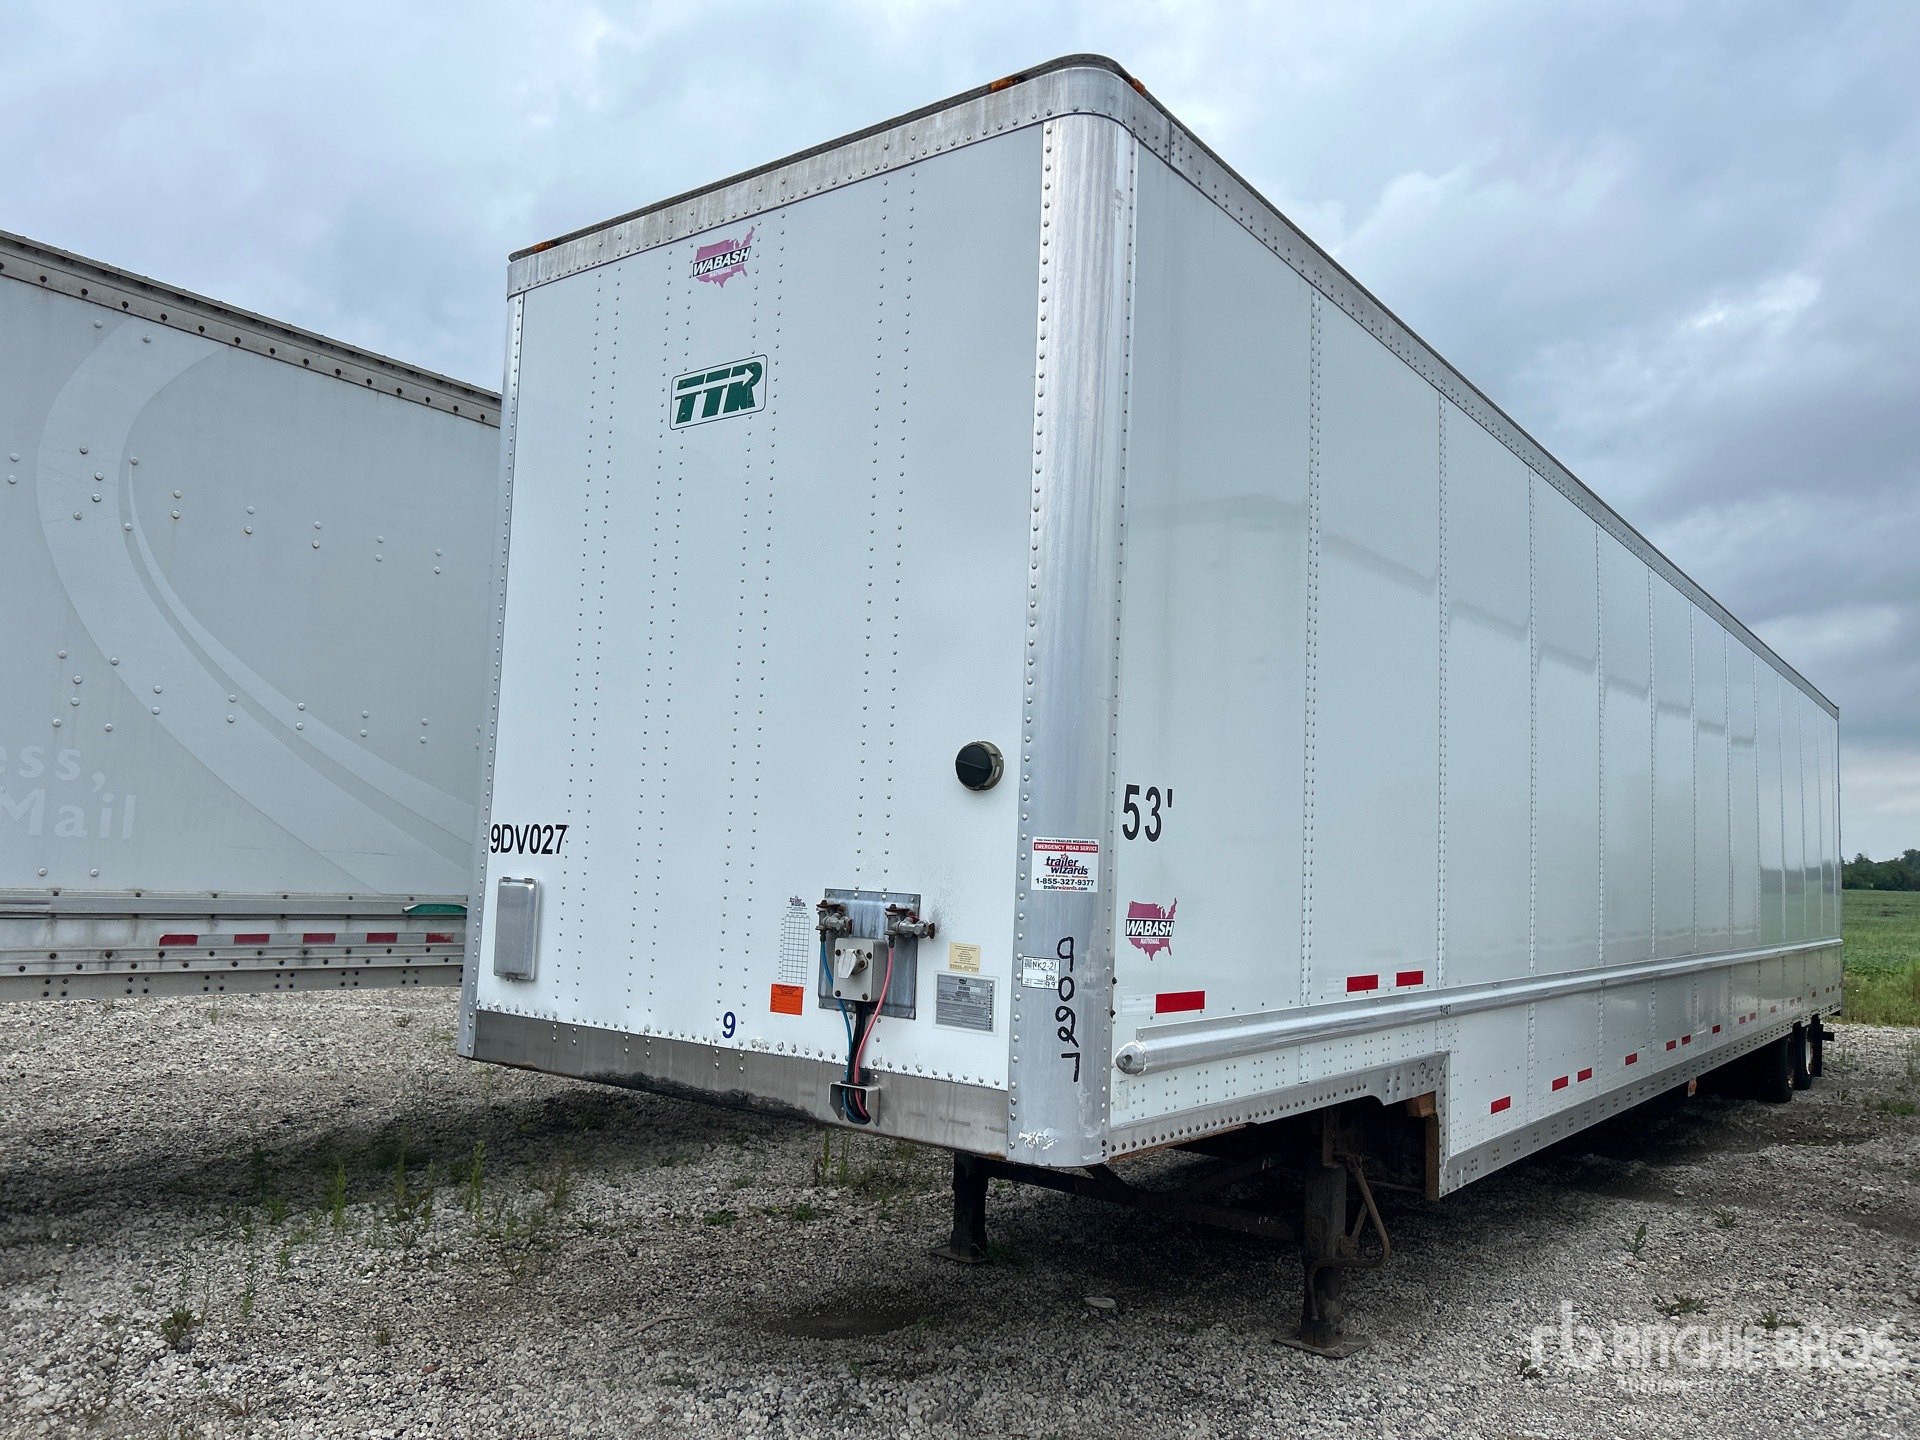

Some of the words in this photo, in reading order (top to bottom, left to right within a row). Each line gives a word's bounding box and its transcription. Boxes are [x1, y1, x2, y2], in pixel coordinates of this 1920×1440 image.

[693, 247, 751, 276] WABASH
[675, 361, 763, 425] TTR
[1122, 783, 1174, 843] 53'
[490, 823, 568, 855] 9DV027
[1035, 843, 1065, 851] EMERGENCY
[1065, 844, 1080, 852] ROAD
[1045, 854, 1079, 868] trailer
[1051, 866, 1088, 875] wizards
[1126, 920, 1174, 936] WABASH
[722, 1011, 736, 1039] 9
